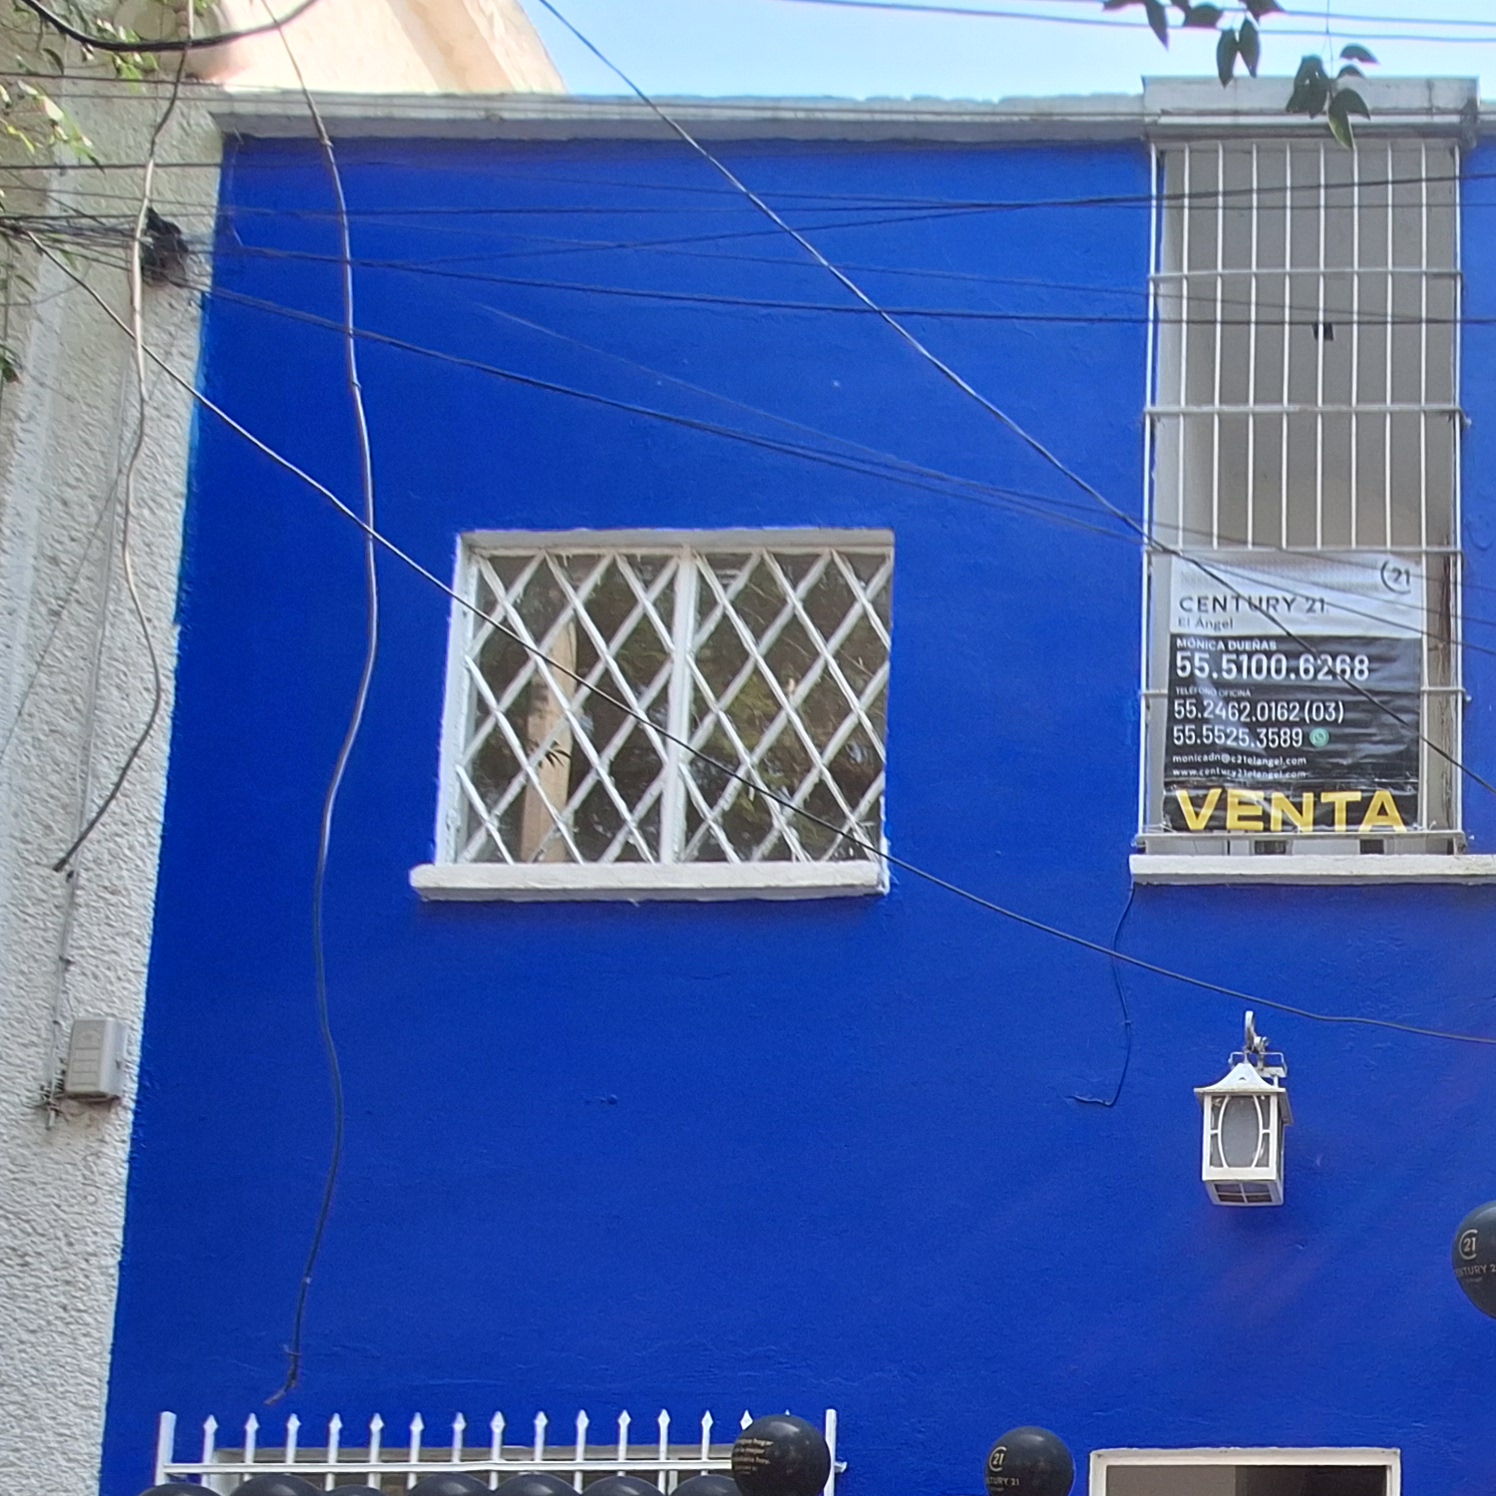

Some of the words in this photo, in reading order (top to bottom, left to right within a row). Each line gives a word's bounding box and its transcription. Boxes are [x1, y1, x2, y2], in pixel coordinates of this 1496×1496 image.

[1179, 594, 1298, 614] CENTURY
[1178, 617, 1190, 629] El
[1195, 616, 1234, 632] Ángel
[1176, 637, 1225, 650] MÓNICA
[1228, 638, 1277, 651] DUEÑAS
[1175, 651, 1370, 681] 55.5100.6268
[1173, 699, 1300, 723] 55.2462.0162
[1304, 700, 1344, 724] (03)
[1173, 724, 1303, 748] 55.5525.3589
[1175, 788, 1408, 833] VENTA
